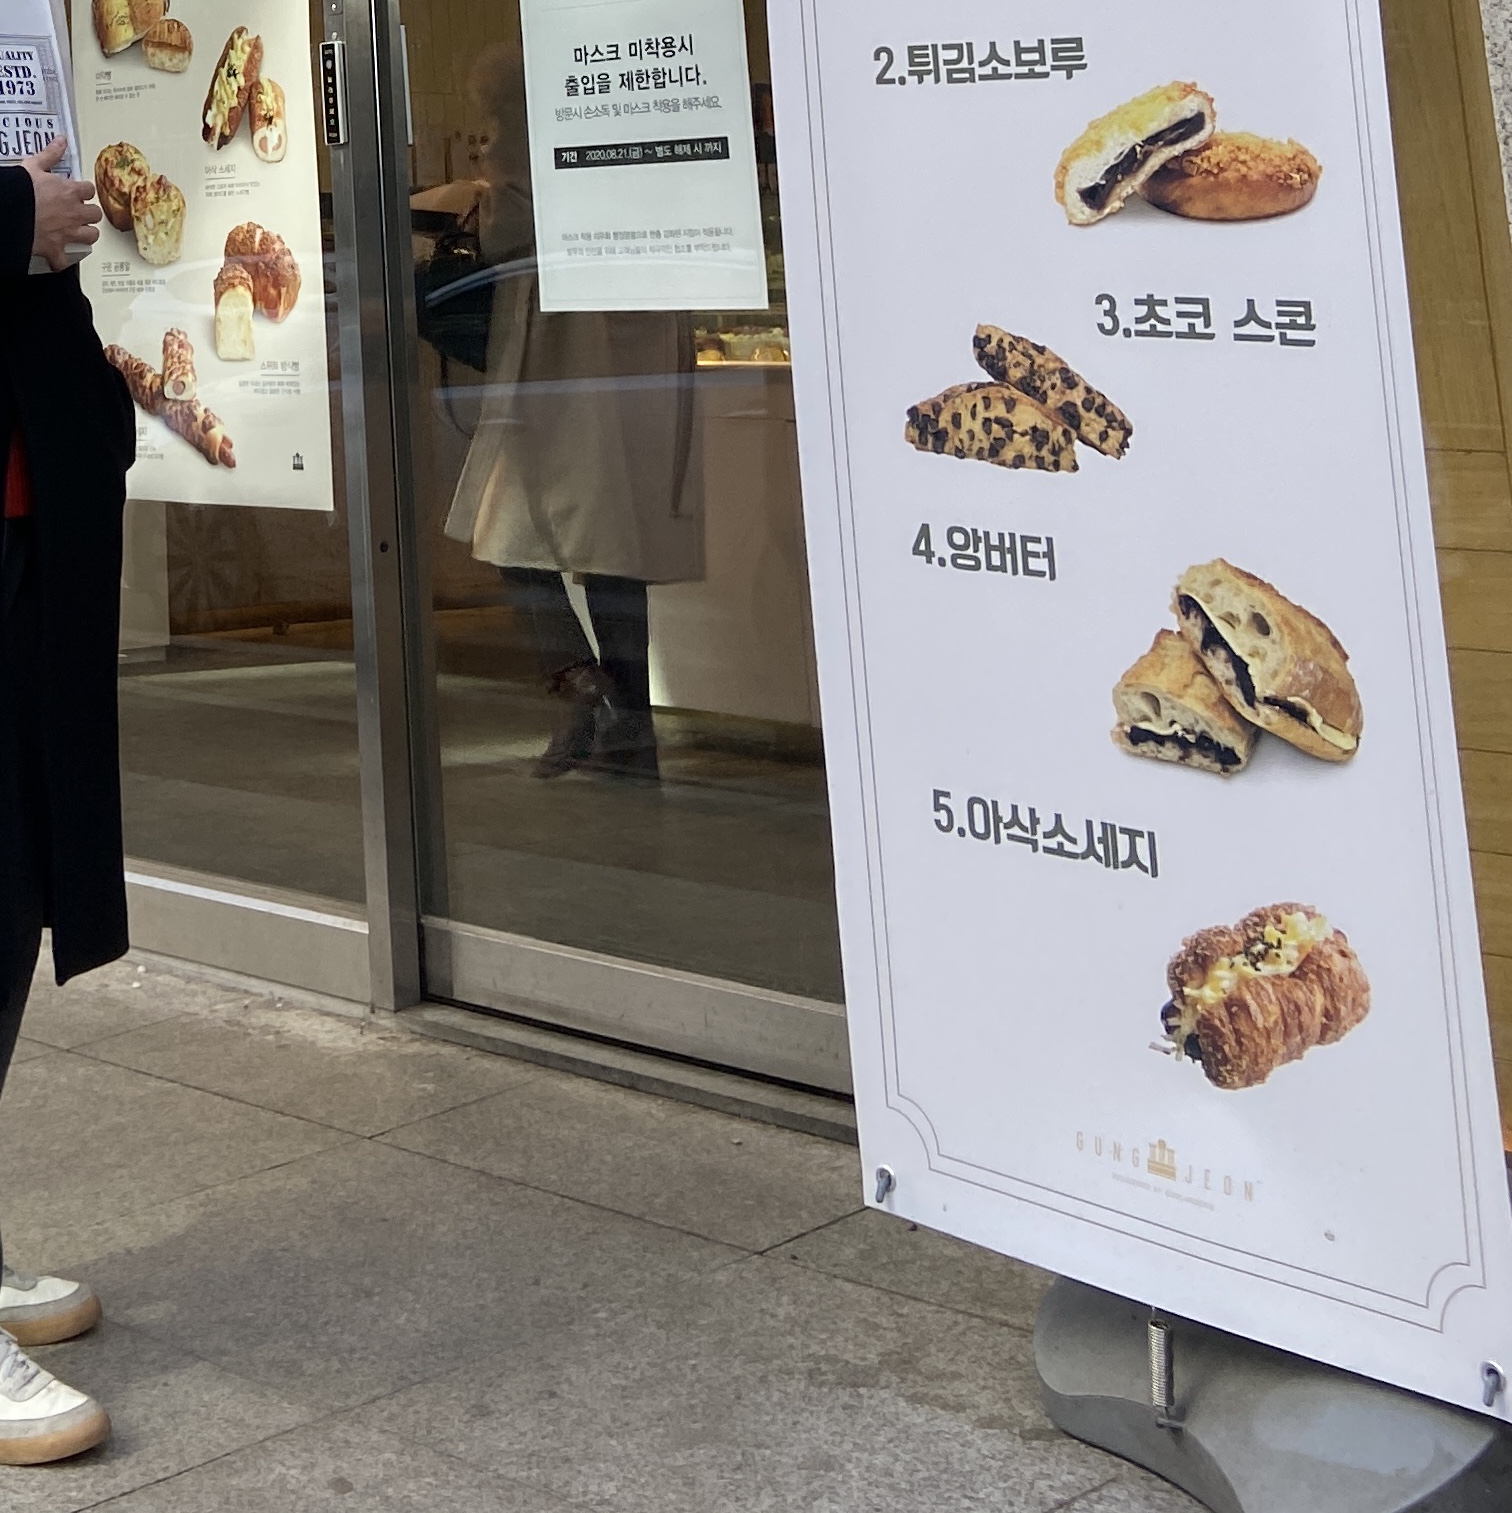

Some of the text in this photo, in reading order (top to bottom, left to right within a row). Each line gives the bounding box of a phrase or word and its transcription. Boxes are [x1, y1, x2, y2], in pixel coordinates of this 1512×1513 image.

[574, 33, 694, 66] 마스크 미착용시
[873, 36, 1088, 85] 2.튀김소보루
[564, 63, 707, 97] 출입을 제한합니다.
[623, 101, 651, 114] 마스크
[1094, 293, 1317, 347] 3.초코 스콘
[911, 522, 1057, 581] 4.앙버터
[932, 788, 1159, 879] 5.아삭소세지
